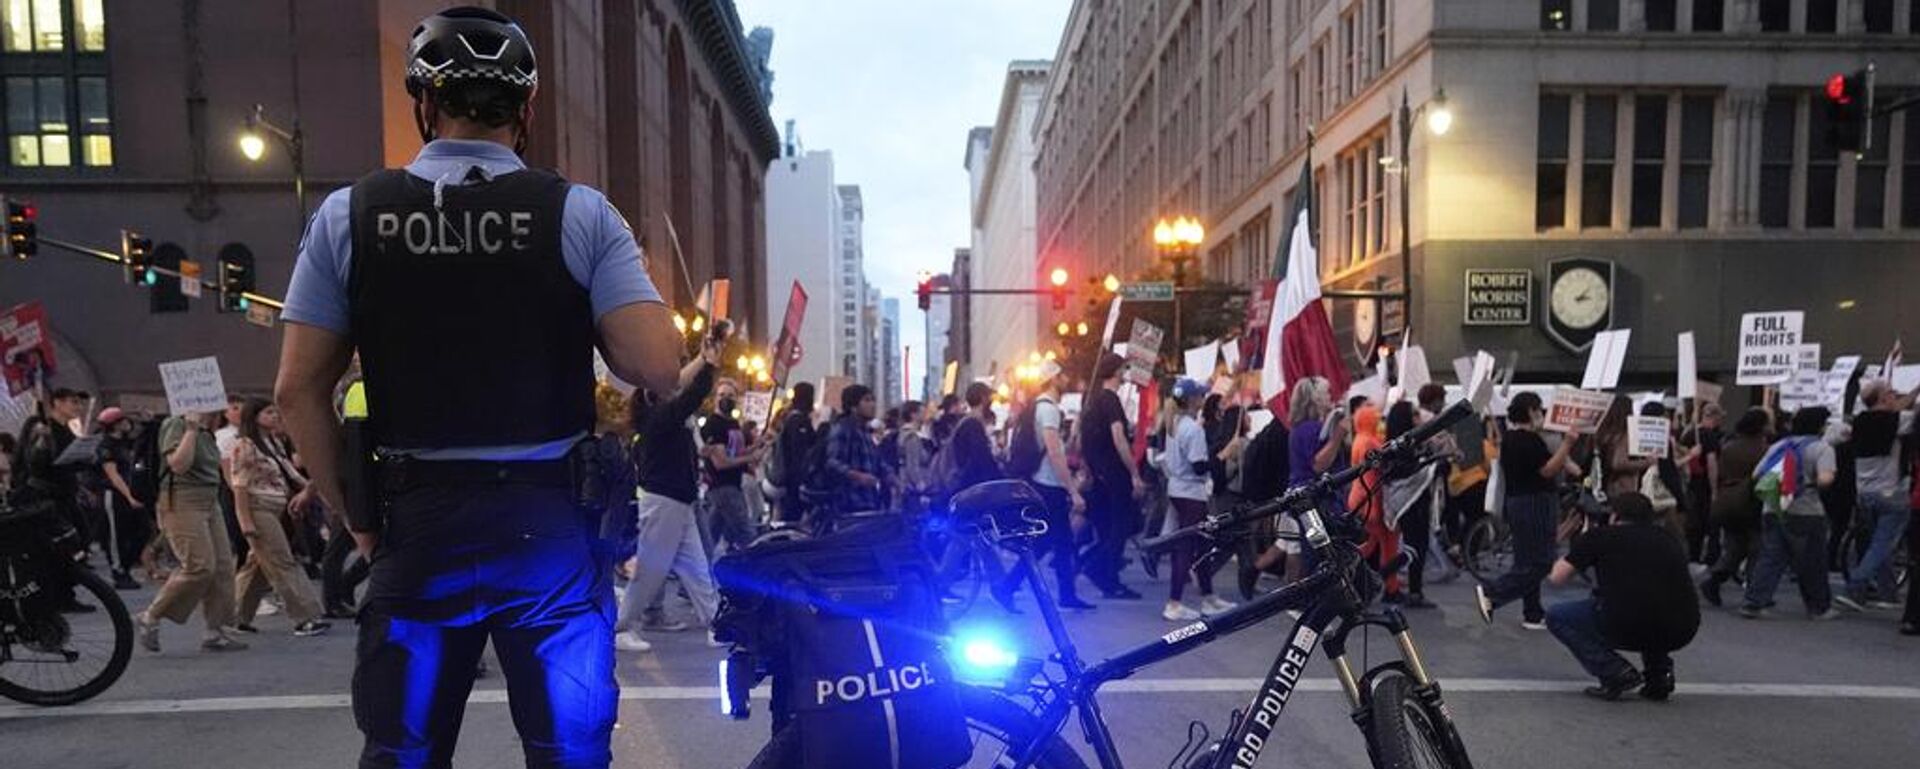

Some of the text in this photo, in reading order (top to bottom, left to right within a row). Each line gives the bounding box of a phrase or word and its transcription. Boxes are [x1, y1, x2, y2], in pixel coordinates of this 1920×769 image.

[377, 211, 532, 254] POLICE
[1471, 273, 1526, 287] ROBERT
[1471, 290, 1527, 303] MORRIS
[1472, 308, 1522, 319] CENTER
[1754, 315, 1787, 331] FULL
[1745, 332, 1796, 346] RIGHTS
[1745, 355, 1767, 366] FOR
[1771, 354, 1792, 365] ALL
[817, 662, 935, 704] POLICE
[1254, 646, 1311, 730] POLICE
